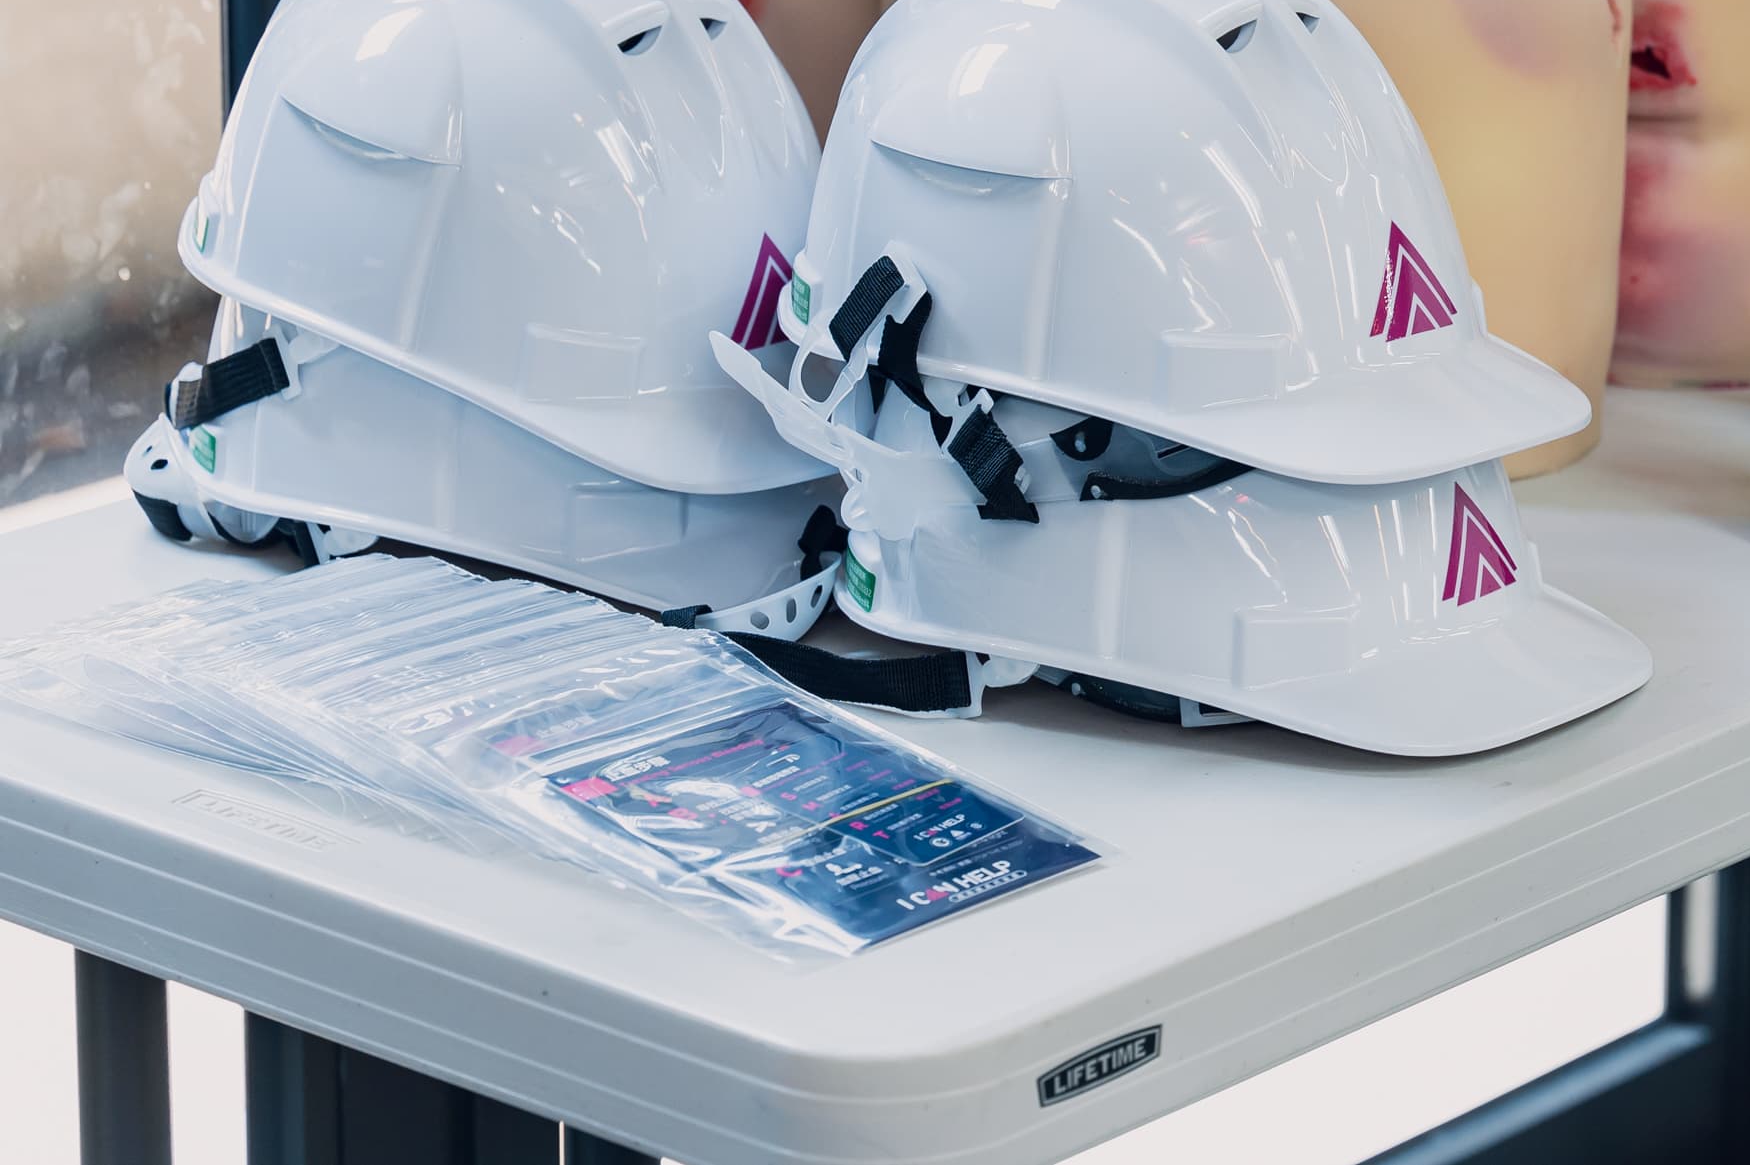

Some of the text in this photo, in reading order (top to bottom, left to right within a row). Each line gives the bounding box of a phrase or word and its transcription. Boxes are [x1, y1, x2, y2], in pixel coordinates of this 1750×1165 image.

[939, 813, 967, 829] HELP
[895, 897, 915, 911] I
[909, 880, 960, 906] CAN
[952, 859, 1012, 889] HELP
[1053, 1037, 1147, 1095] LIFETIME
